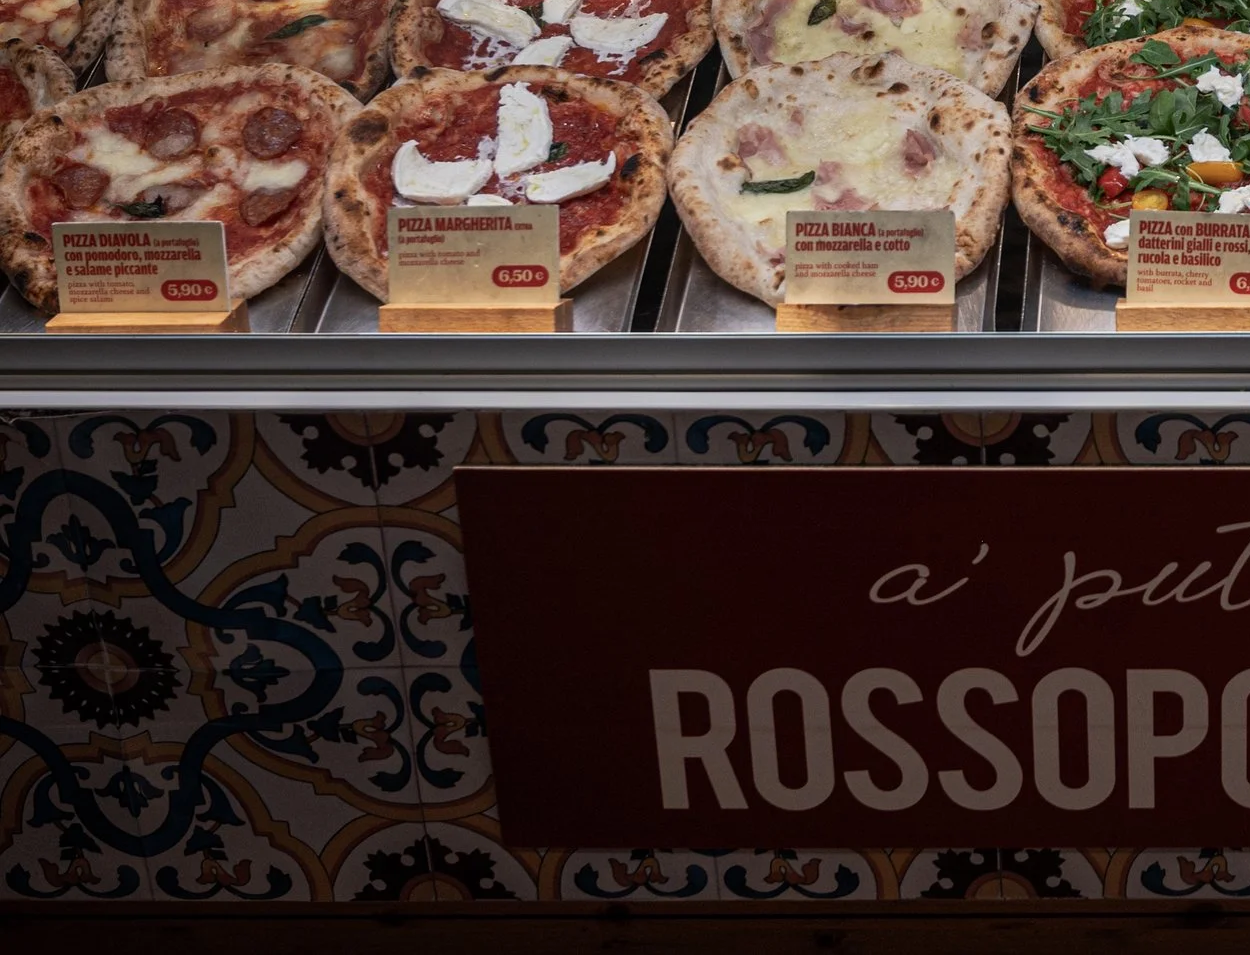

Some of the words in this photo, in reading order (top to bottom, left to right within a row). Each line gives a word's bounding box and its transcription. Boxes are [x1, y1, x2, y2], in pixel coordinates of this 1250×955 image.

[398, 218, 432, 232] PIZZA
[435, 217, 512, 231] MARGHERITA
[796, 223, 829, 236] PIZZA
[832, 223, 875, 236] BIANCA
[1139, 221, 1172, 235] PIZZA
[1175, 225, 1192, 236] con
[63, 234, 97, 246] PIZZA
[100, 233, 149, 246] DIAVOLA
[795, 241, 813, 251] con
[816, 238, 872, 251] mozzarella
[875, 241, 880, 251] e
[884, 239, 910, 251] cotto
[1139, 236, 1184, 250] datterini
[1187, 239, 1212, 253] gialli
[1216, 243, 1220, 252] e
[1224, 242, 1250, 255] rossi,
[65, 251, 82, 261] con
[85, 249, 142, 263] pomodoro,
[145, 249, 201, 260] mozzarella
[1138, 252, 1170, 264] rucola
[1173, 256, 1178, 265] e
[1181, 253, 1221, 266] basilico
[67, 266, 72, 275] e
[75, 264, 112, 275] salame
[115, 264, 158, 277] piccante
[1156, 269, 1184, 278] burrata,
[1185, 270, 1208, 279] cherry
